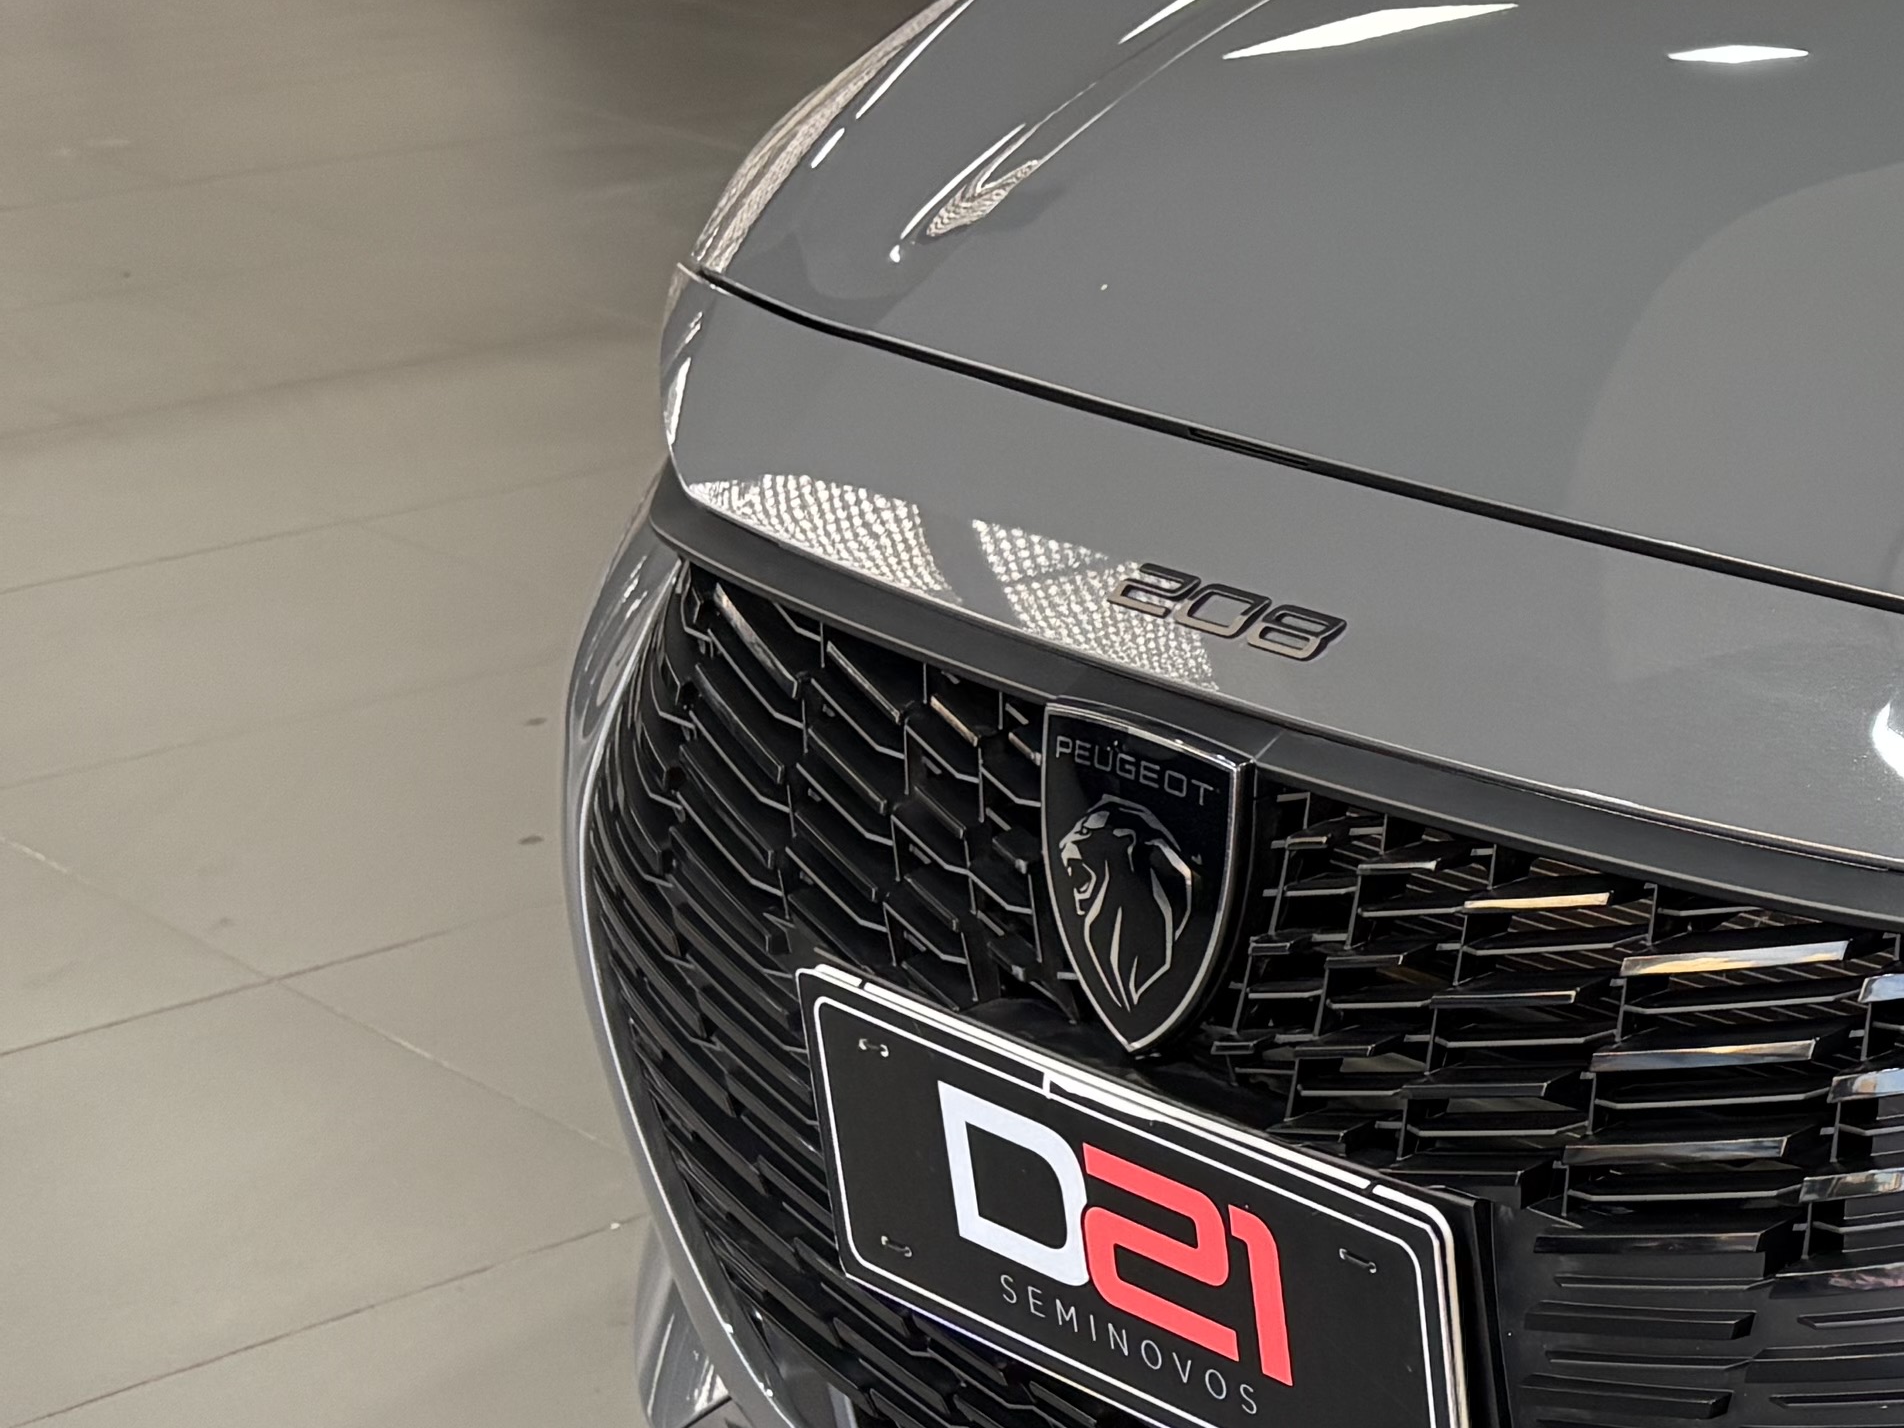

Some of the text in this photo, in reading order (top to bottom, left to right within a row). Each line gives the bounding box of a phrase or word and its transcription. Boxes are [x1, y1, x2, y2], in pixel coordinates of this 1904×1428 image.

[1106, 562, 1348, 662] 208
[1055, 734, 1216, 808] PEUGEOT
[936, 1080, 1294, 1387] D21
[999, 1272, 1259, 1417] SEMINOVOS
